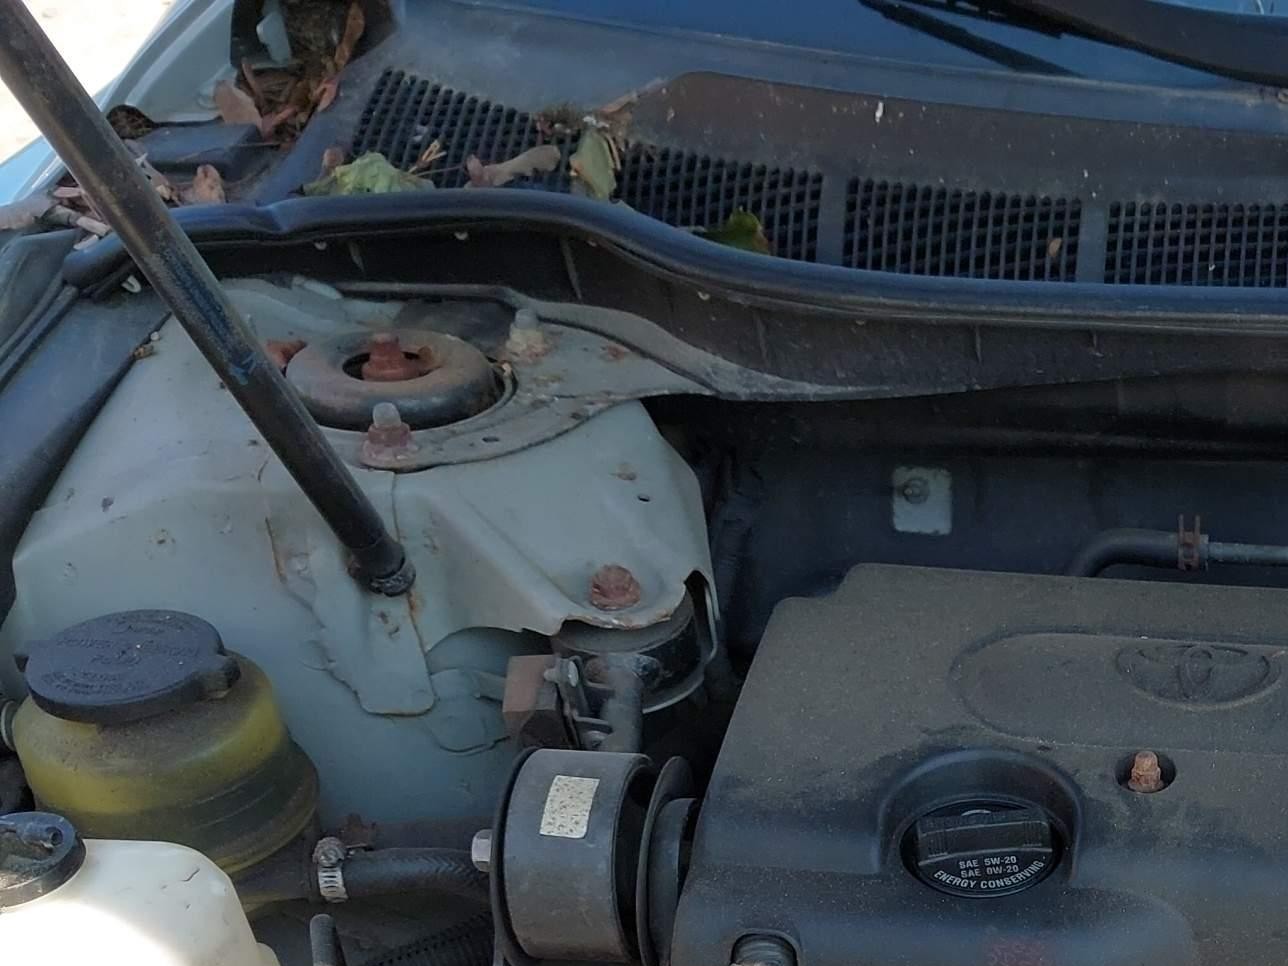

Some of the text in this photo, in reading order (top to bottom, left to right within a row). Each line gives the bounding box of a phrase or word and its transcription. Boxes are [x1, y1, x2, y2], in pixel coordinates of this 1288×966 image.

[959, 855, 1017, 870] SAE 5W-20
[933, 860, 1045, 889] ENERGY CONSERVING
[961, 864, 1019, 879] SAE 0W-20
